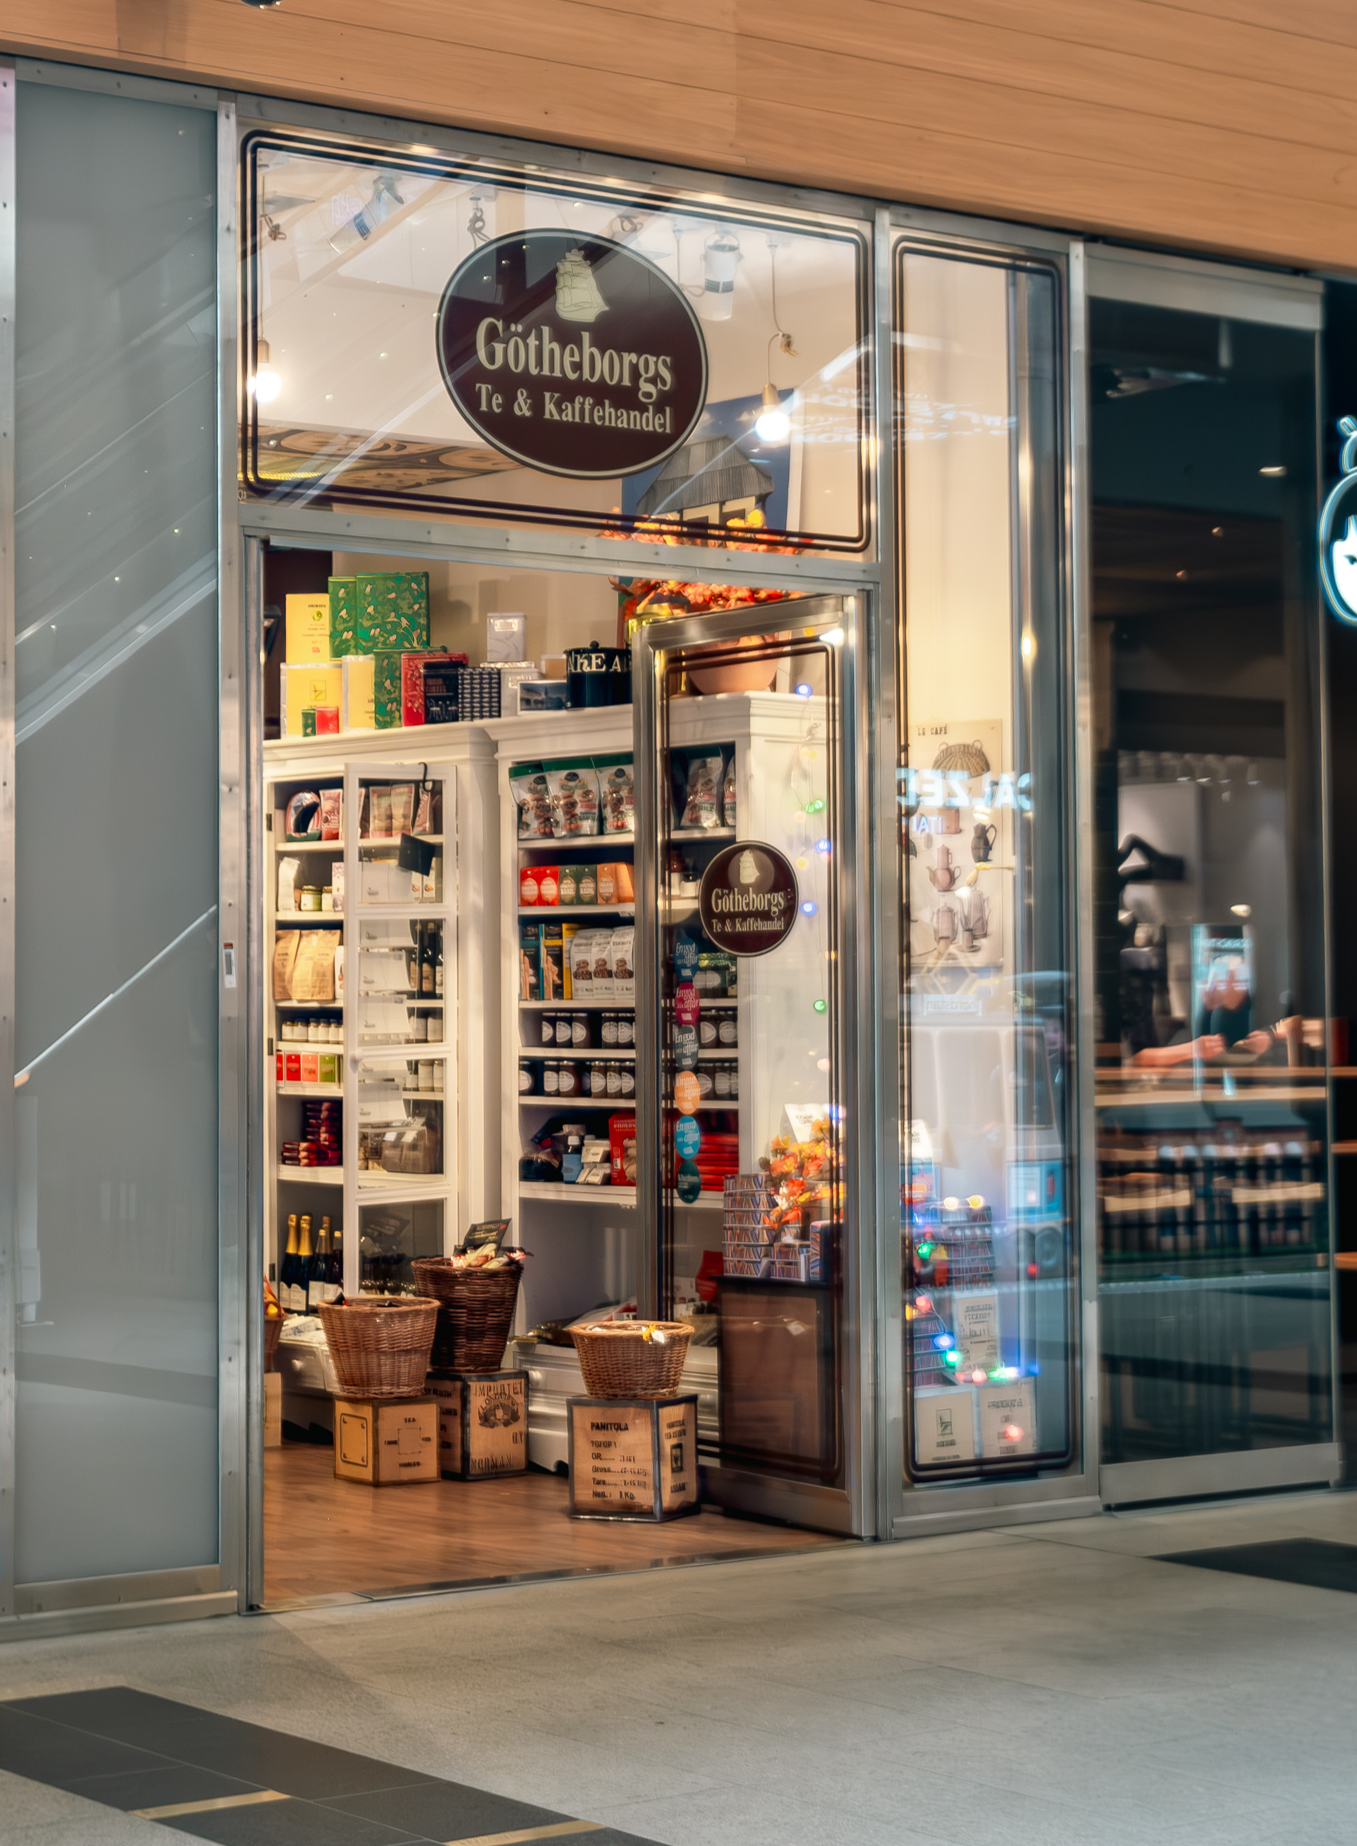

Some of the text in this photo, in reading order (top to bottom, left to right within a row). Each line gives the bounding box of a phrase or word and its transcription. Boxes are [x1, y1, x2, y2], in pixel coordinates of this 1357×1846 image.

[476, 316, 673, 403] Götheborgs
[476, 383, 672, 434] Te & Kaffehandel
[711, 886, 785, 917] Götheborgs
[711, 916, 784, 933] Te & Kaffehandel
